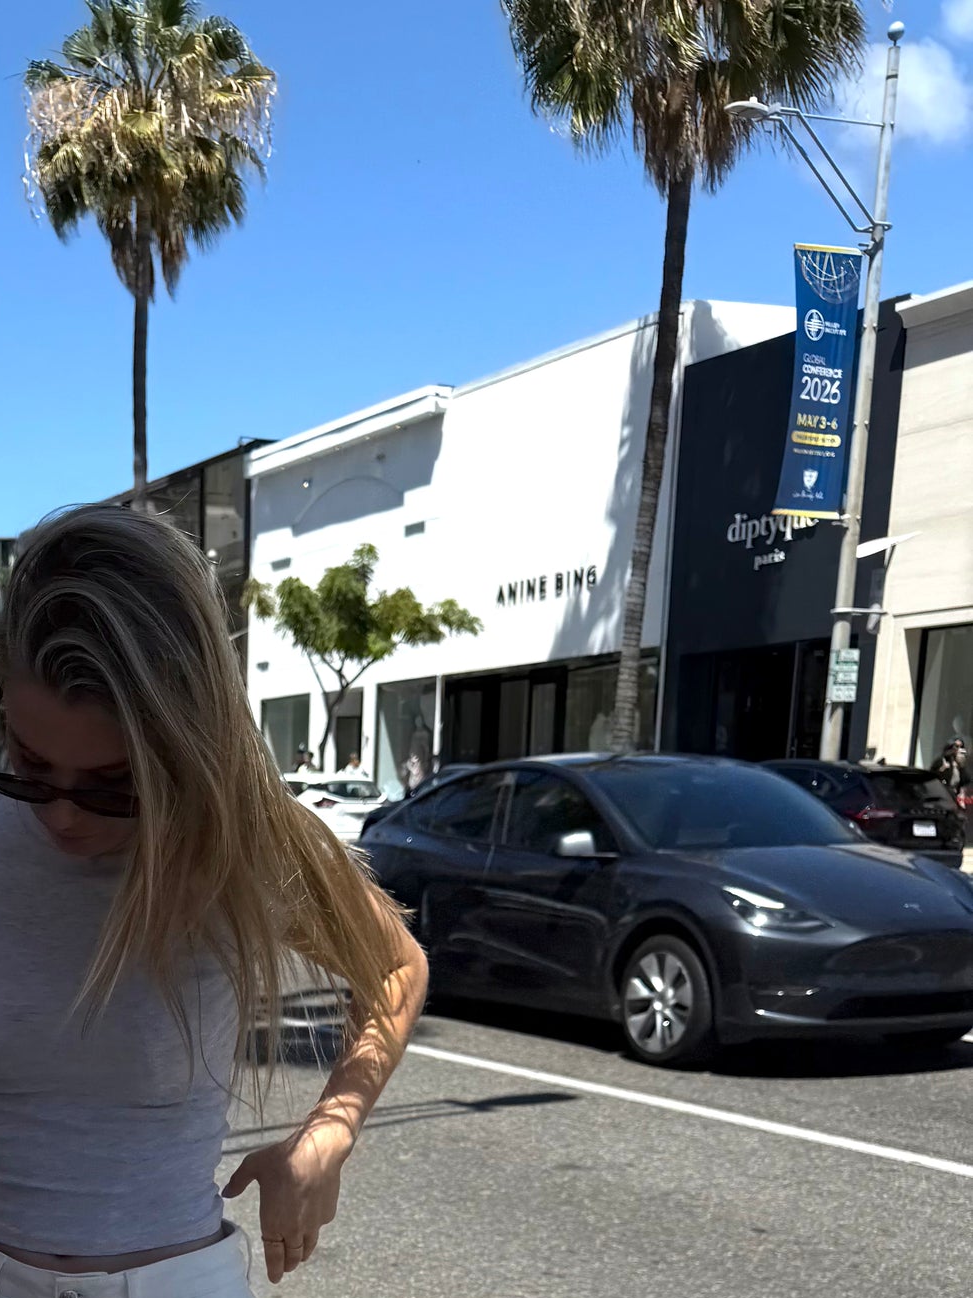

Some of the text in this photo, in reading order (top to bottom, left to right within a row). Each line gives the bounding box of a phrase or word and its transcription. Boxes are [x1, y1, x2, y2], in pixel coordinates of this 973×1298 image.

[802, 364, 843, 379] CONFERENCE
[800, 376, 841, 404] 2026
[796, 413, 839, 430] MAY 3-6
[495, 565, 597, 607] ANINE BING
